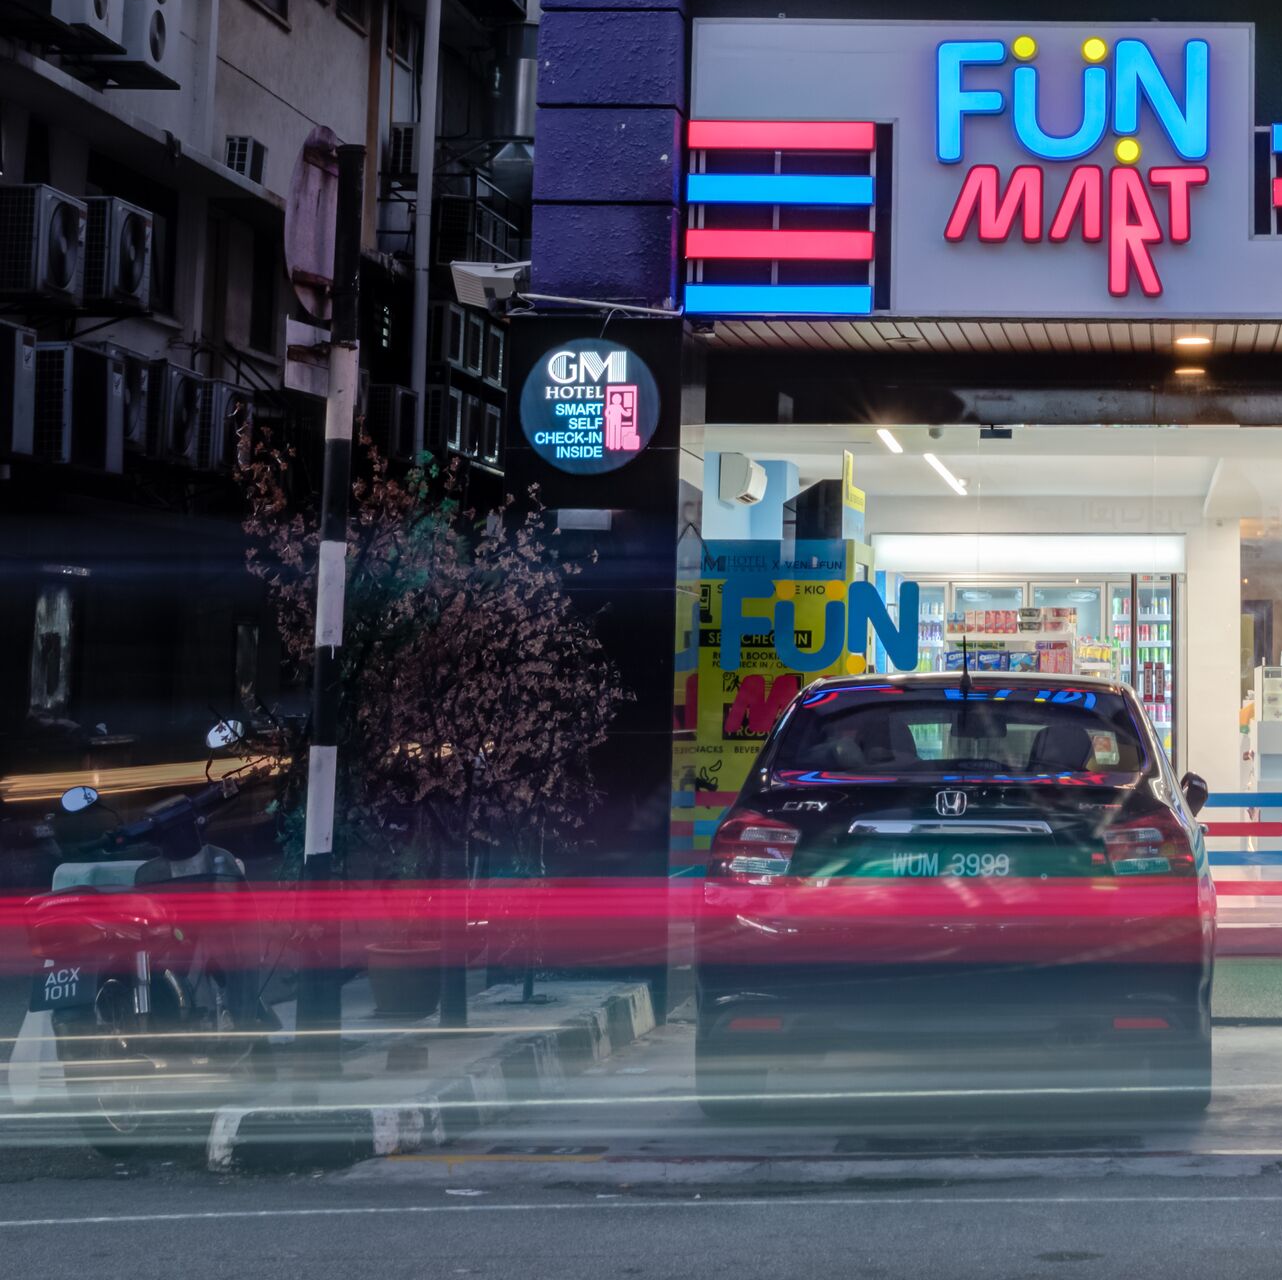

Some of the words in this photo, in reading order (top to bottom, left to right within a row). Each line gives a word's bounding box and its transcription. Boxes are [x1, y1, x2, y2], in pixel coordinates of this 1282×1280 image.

[943, 164, 1210, 297] MART
[547, 350, 627, 383] GM
[545, 385, 605, 400] HOTEL
[555, 403, 604, 416] SMART
[568, 417, 604, 430] SELF
[534, 432, 603, 444] CHECK-IN
[556, 445, 603, 458] INSIDE
[892, 851, 939, 876] WUM
[951, 853, 1010, 877] 3999
[45, 966, 80, 987] ACX
[44, 983, 77, 1001] 1011
